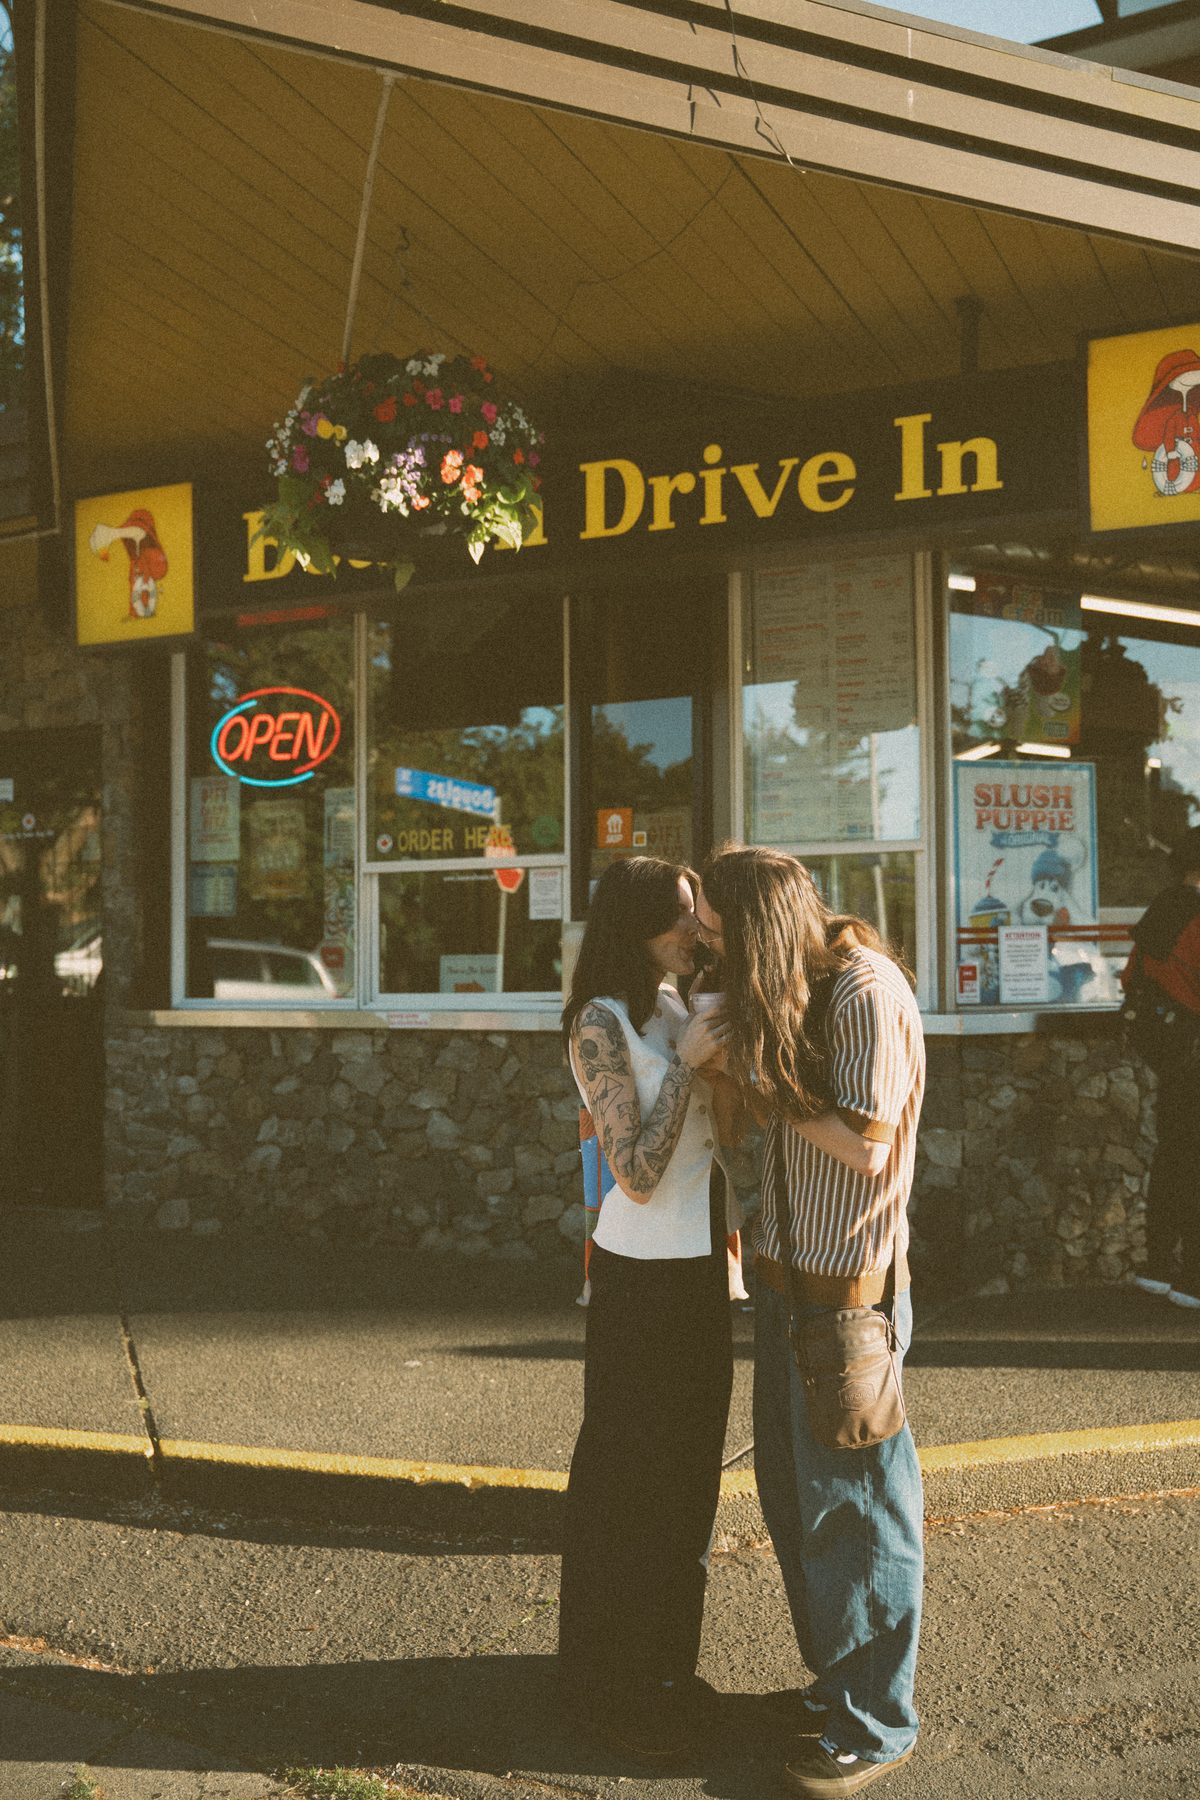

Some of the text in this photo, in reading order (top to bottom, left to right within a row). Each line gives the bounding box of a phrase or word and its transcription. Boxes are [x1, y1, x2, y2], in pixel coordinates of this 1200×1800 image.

[579, 413, 1003, 539] Drive In
[218, 712, 329, 761] OPEN
[973, 783, 1074, 809] SLUSH
[397, 825, 512, 852] ORDER HERE
